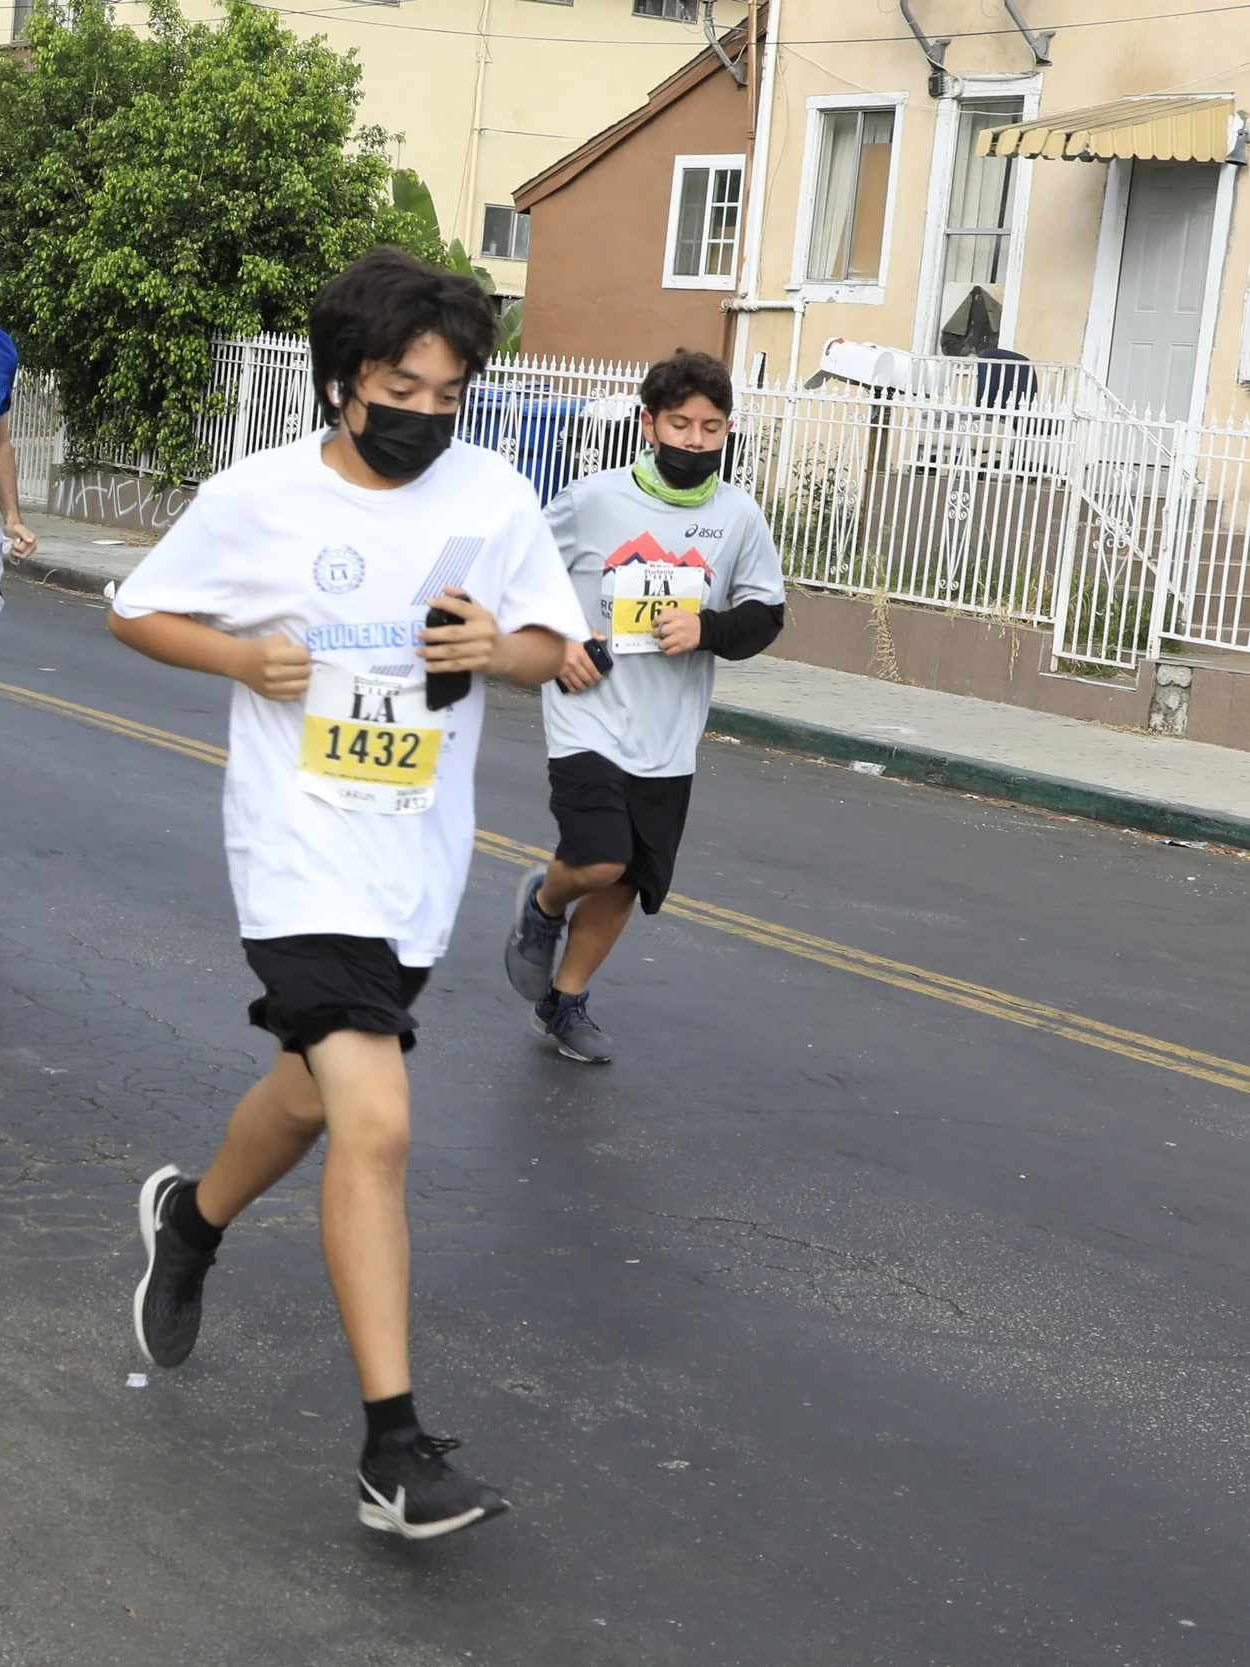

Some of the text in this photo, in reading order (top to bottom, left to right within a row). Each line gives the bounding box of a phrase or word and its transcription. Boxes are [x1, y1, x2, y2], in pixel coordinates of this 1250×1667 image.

[642, 580, 672, 597] LA
[306, 622, 407, 652] STUDENTS
[349, 692, 397, 724] LA
[325, 724, 421, 769] 1432
